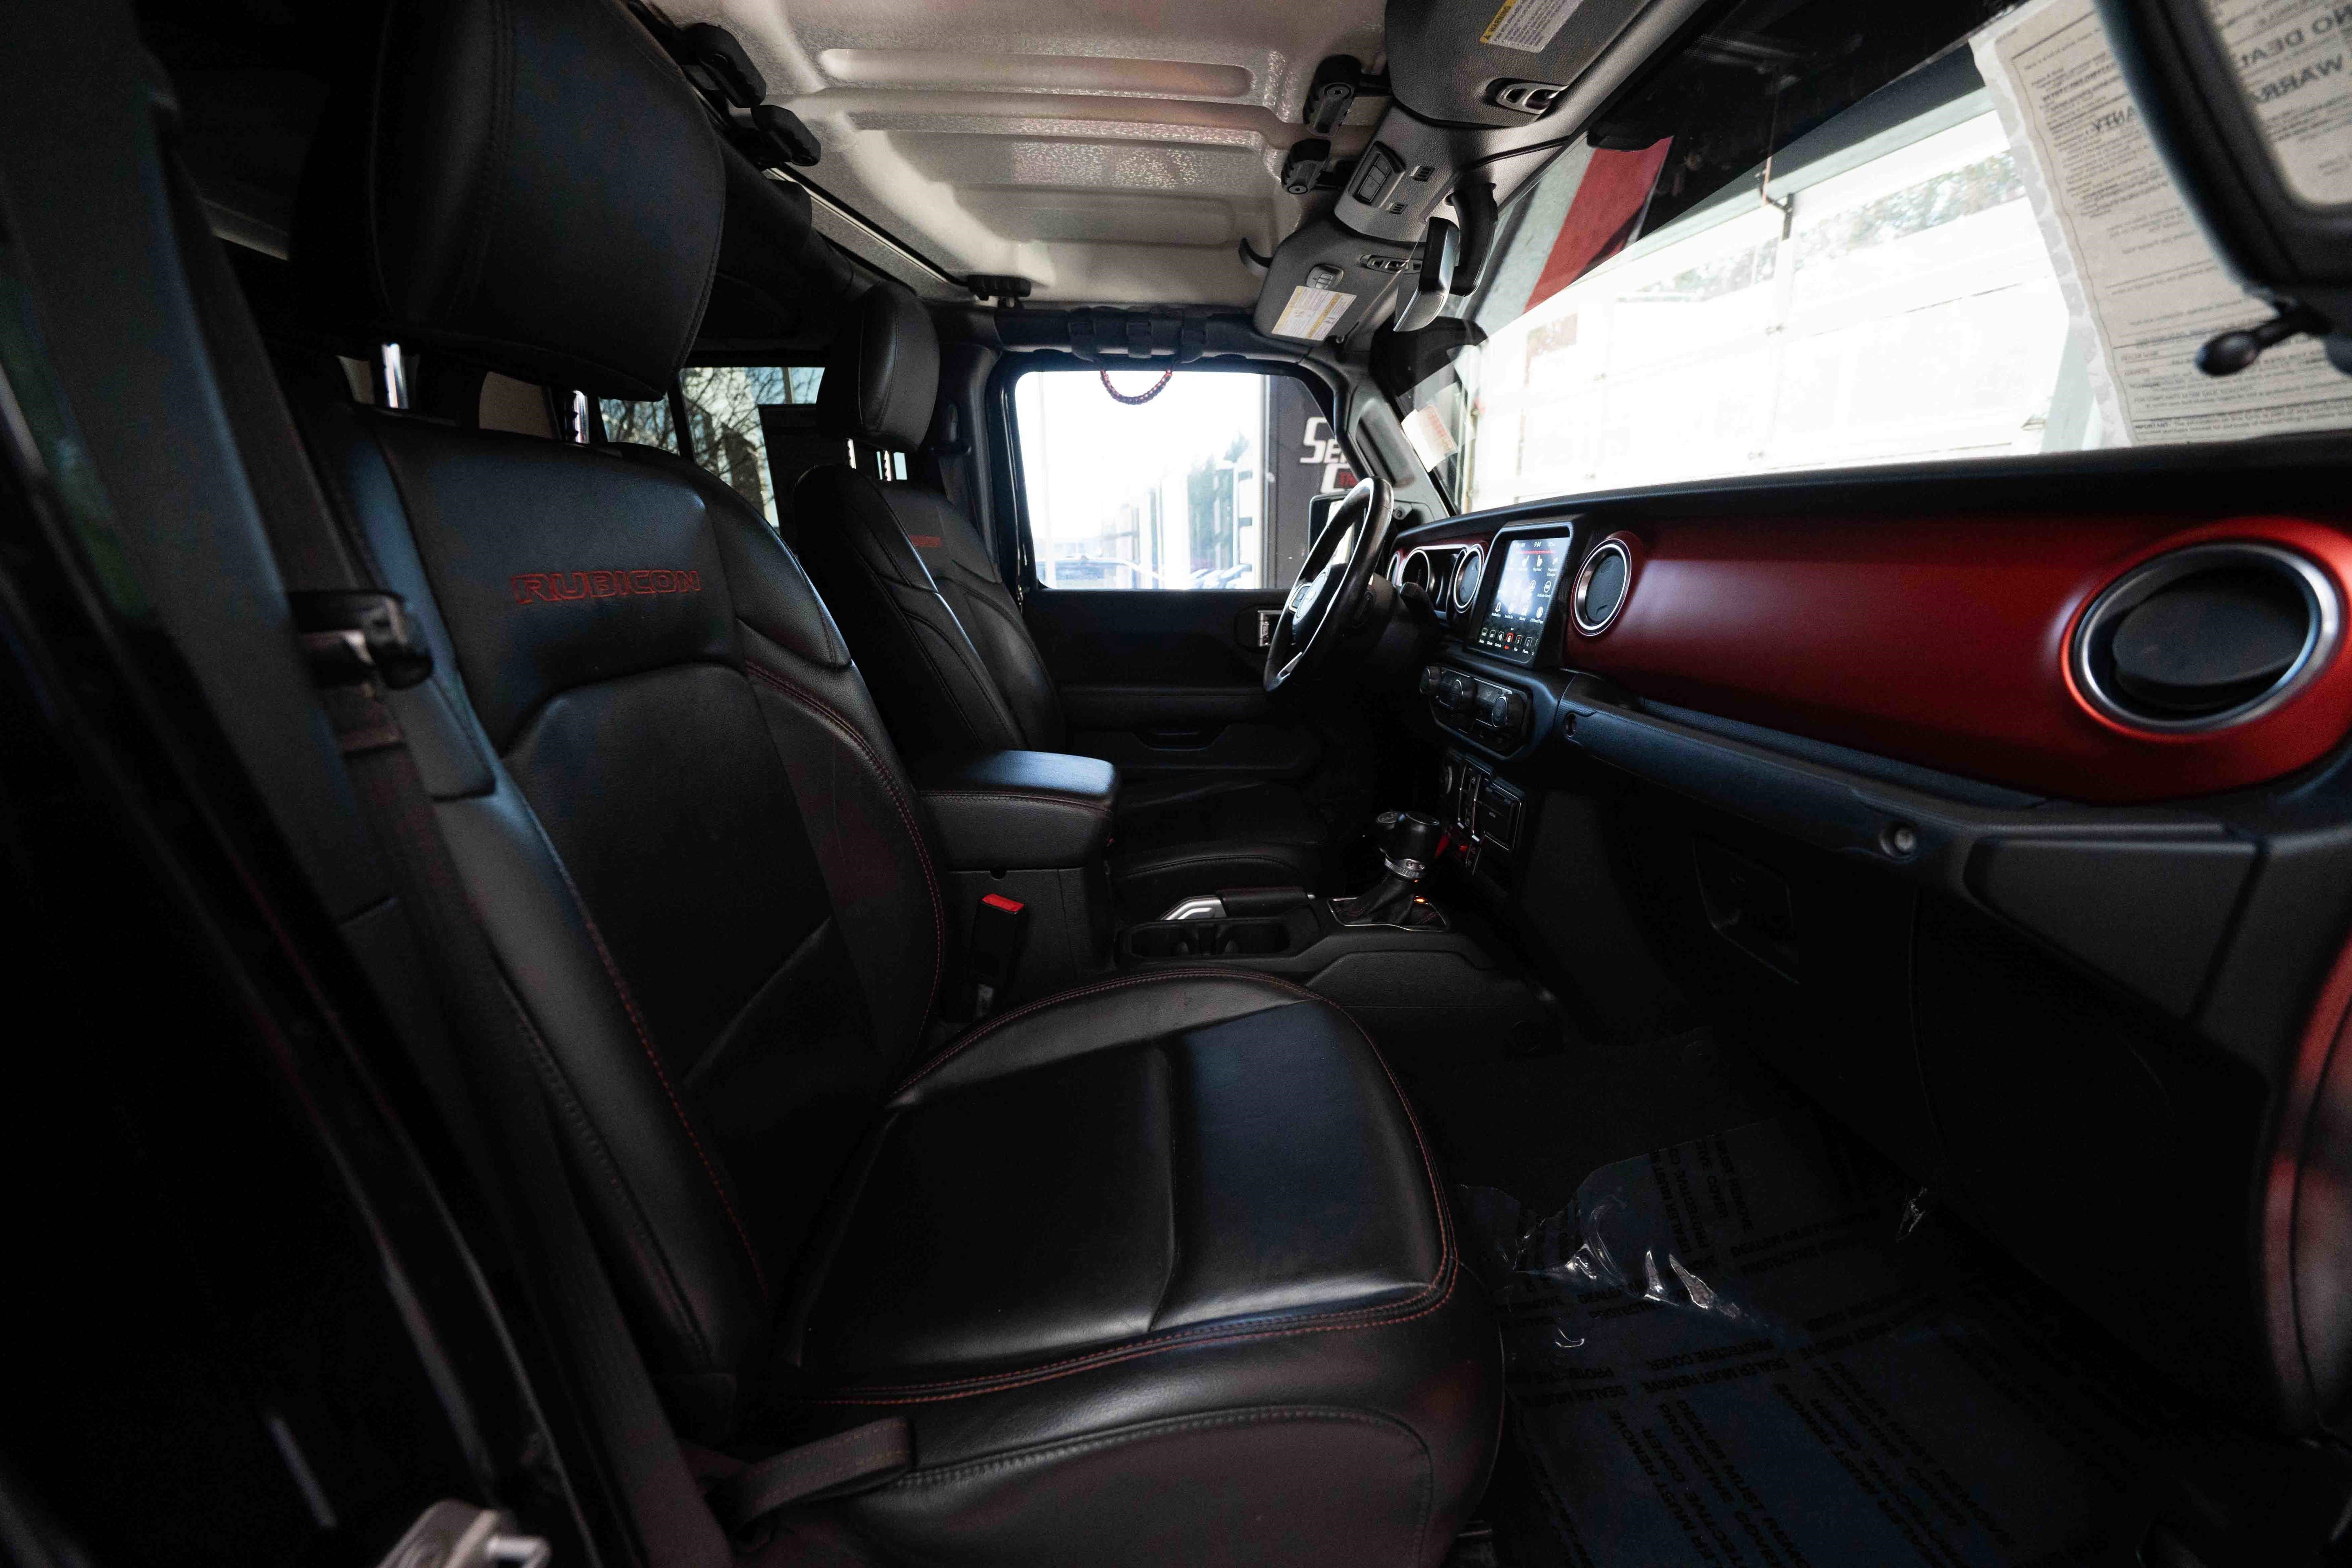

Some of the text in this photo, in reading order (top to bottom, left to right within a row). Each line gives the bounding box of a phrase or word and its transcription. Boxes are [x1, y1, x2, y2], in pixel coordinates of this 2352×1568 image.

[1489, 5, 1512, 32] WARNING
[1300, 417, 1347, 463] SE
[510, 570, 702, 604] RUBICON
